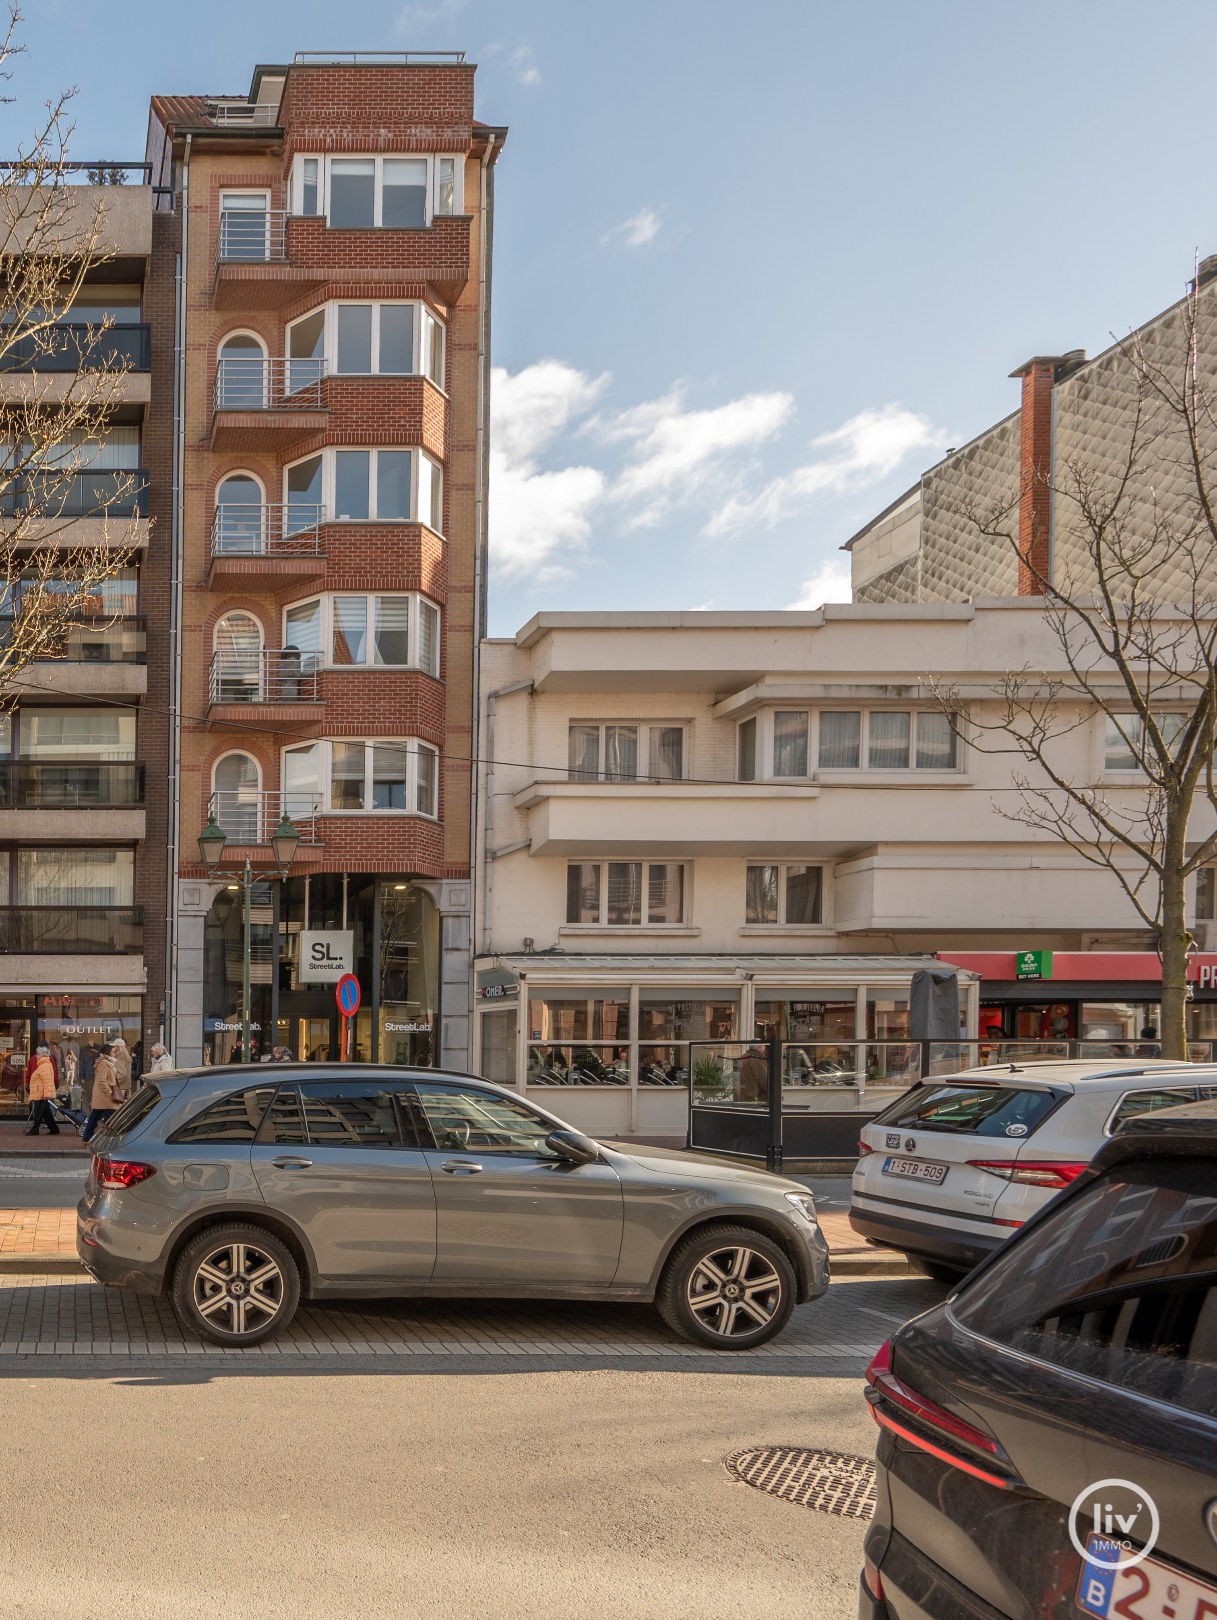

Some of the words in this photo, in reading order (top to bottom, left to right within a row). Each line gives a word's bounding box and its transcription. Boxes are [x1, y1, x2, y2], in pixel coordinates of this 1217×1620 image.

[66, 1026, 112, 1034] OUTLET
[214, 1022, 262, 1031] Streetab.
[384, 1022, 432, 1032] StreetLab.
[890, 1160, 944, 1179] 1-STB-509
[1086, 1579, 1106, 1607] B
